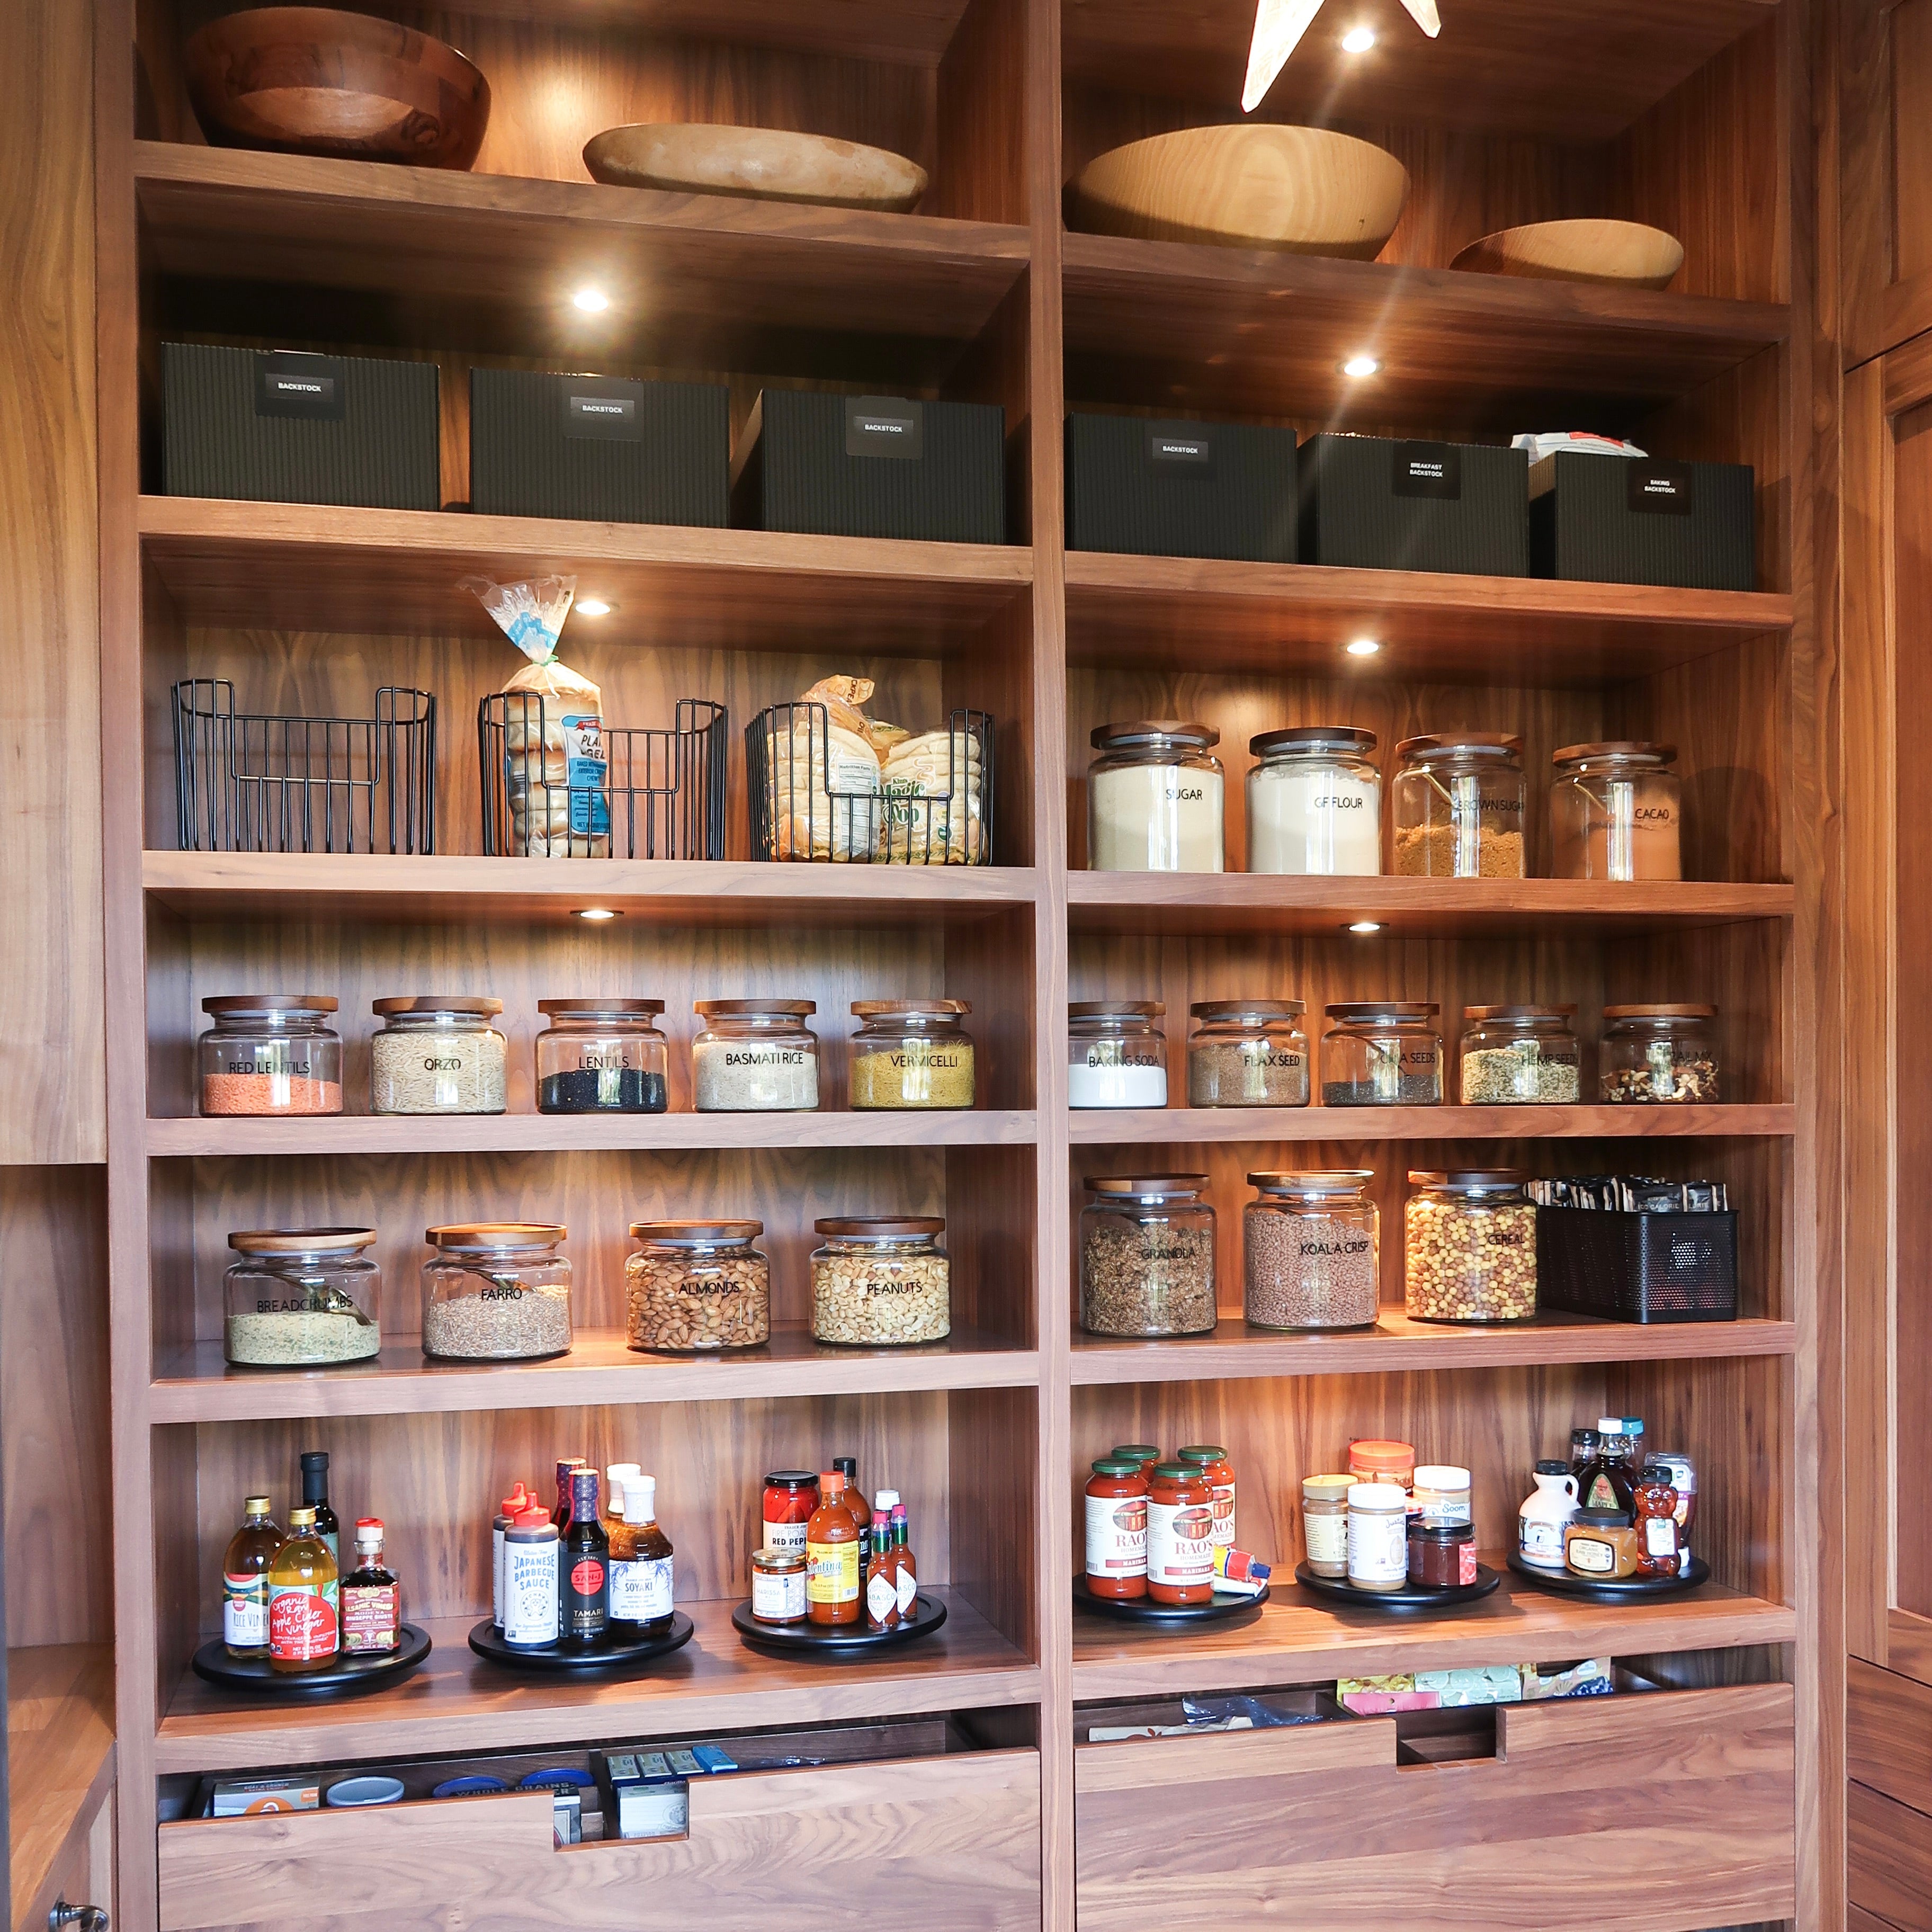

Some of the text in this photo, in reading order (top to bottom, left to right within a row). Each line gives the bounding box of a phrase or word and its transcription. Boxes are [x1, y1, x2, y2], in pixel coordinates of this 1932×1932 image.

[278, 382, 322, 392] BACKSTOCK
[582, 405, 623, 414] BACKSTOCK
[864, 424, 902, 433] BACKSTOCK
[1162, 445, 1198, 454] BACKSTOCK
[1409, 469, 1443, 478] BACKSTOCK
[580, 748, 605, 759] GEL
[1165, 789, 1203, 800] SUGAR
[1314, 797, 1364, 809] GF FLOUR
[1635, 808, 1669, 820] CACAO
[578, 1056, 630, 1069] LENTILS
[726, 1052, 804, 1066] BASMATI RICE
[890, 1055, 958, 1068] VERMICELLI
[1089, 1056, 1159, 1068] BAKING SODA
[1244, 1054, 1300, 1067] FLAX SEED
[1410, 1052, 1435, 1064] SEEDS
[1521, 1053, 1554, 1066] HEMP
[229, 1061, 254, 1075] RED
[424, 1058, 462, 1071] ORZO
[1488, 1233, 1525, 1246] CEREAL
[1141, 1246, 1196, 1260] GRANOLA
[1300, 1240, 1369, 1256] KOALA CRISP
[481, 1287, 523, 1301] FARRO
[678, 1281, 740, 1295] ALMONDS
[866, 1282, 923, 1295] PEANUTS
[257, 1295, 353, 1314] BREADCRUMBS
[1442, 1503, 1465, 1514] Soom
[1174, 1539, 1213, 1555] RAO'S
[514, 1553, 554, 1570] JAPANESE
[514, 1568, 554, 1582] BARBECUE
[1181, 1566, 1210, 1575] MARINARA
[575, 1573, 601, 1582] SAN-J
[520, 1579, 549, 1590] SAUCE
[625, 1581, 652, 1592] SOYAKI
[868, 1592, 896, 1602] ABASCO
[273, 1597, 308, 1614] Organic
[285, 1604, 309, 1615] Raw
[574, 1608, 603, 1617] TAMARI
[233, 1612, 246, 1628] RICE
[272, 1610, 323, 1633] Apple Cider
[456, 1787, 509, 1797] WHOLE
